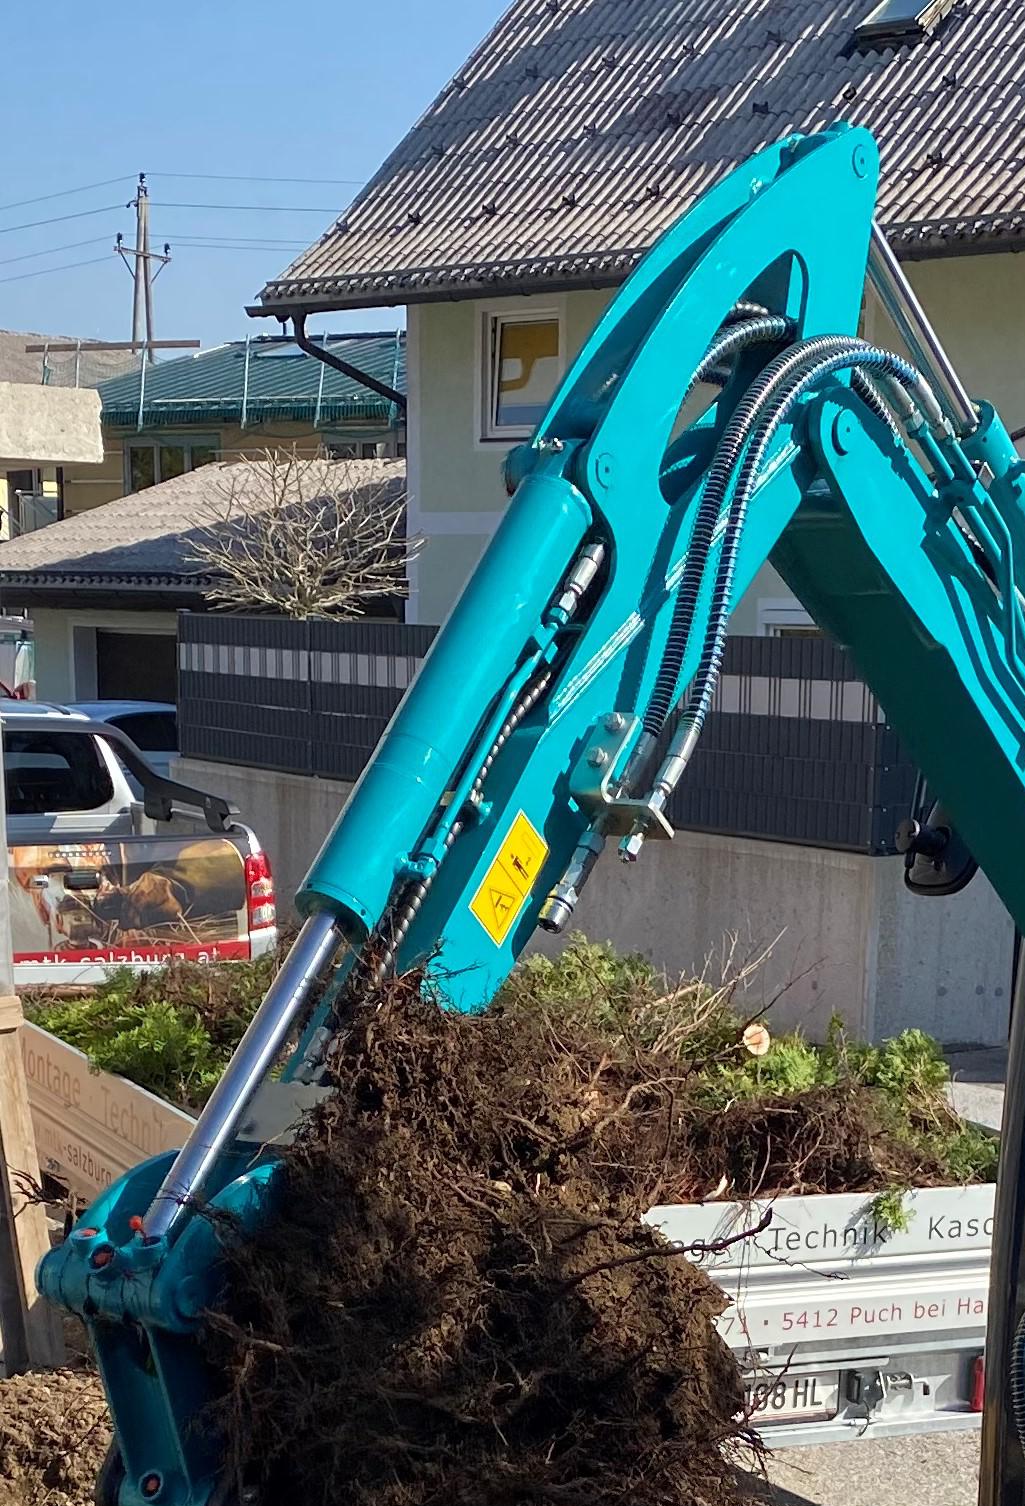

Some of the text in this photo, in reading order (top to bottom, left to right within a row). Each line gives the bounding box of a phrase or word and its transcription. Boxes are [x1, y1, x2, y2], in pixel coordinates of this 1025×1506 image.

[768, 1220, 888, 1251] Technik
[782, 1308, 838, 1330] 5412
[851, 1303, 902, 1325] Puch
[914, 1299, 946, 1319] bei
[957, 1297, 984, 1315] Ha
